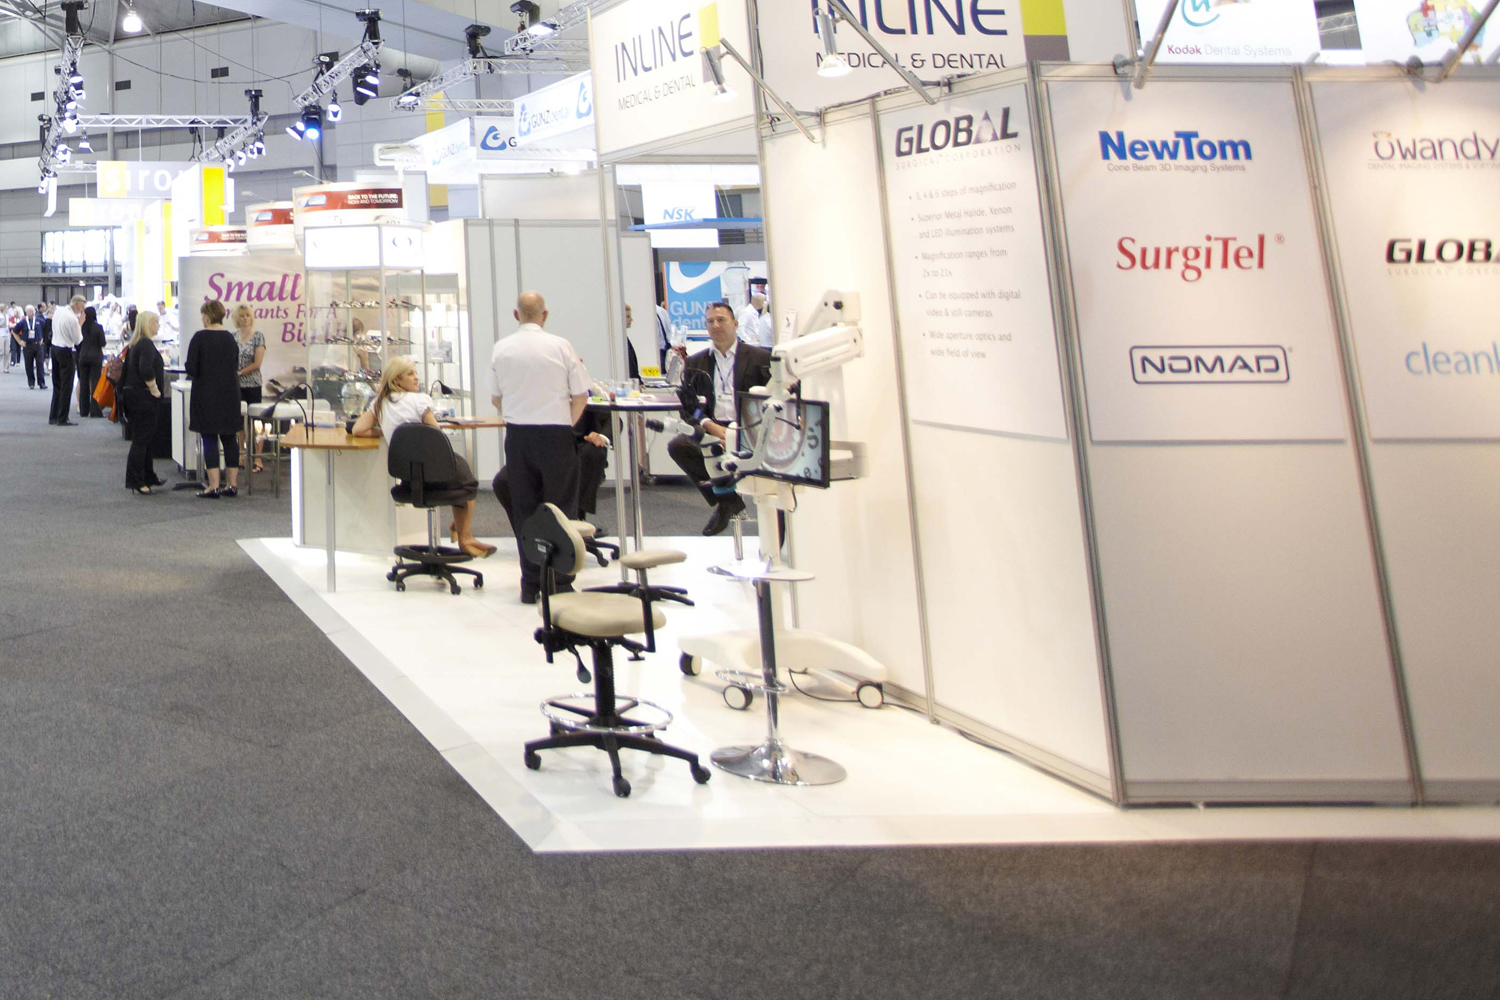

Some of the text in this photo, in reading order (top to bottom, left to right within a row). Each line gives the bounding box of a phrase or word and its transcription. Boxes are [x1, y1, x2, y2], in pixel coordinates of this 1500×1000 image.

[615, 12, 694, 83] INLINE
[1167, 44, 1292, 58] Kodak Dental Systems
[911, 53, 927, 69] &
[932, 53, 1007, 69] DENTAL
[618, 73, 696, 111] MEDICAL & DENTAL
[895, 106, 1019, 158] GLOBAL
[1098, 130, 1253, 161] NewTom
[1107, 163, 1246, 174] Cone Beam 3D Imaging Systems
[969, 181, 1017, 196] magnification
[662, 206, 696, 221] NSK
[917, 212, 942, 223] Superior
[944, 210, 960, 220] Metal
[989, 206, 1012, 216] Xenon
[918, 230, 930, 239] and
[931, 228, 943, 238] LED
[986, 224, 1015, 235] systems
[921, 247, 1008, 262] Magnification ranges from
[1116, 233, 1266, 283] SurgiTel
[1385, 238, 1500, 264] GLOB
[204, 272, 303, 302] Small
[981, 289, 995, 299] with
[997, 288, 1021, 301] digital
[964, 309, 993, 318] cameras
[928, 329, 944, 339] Wide
[998, 332, 1013, 342] and
[1140, 354, 1280, 375] NOMAD
